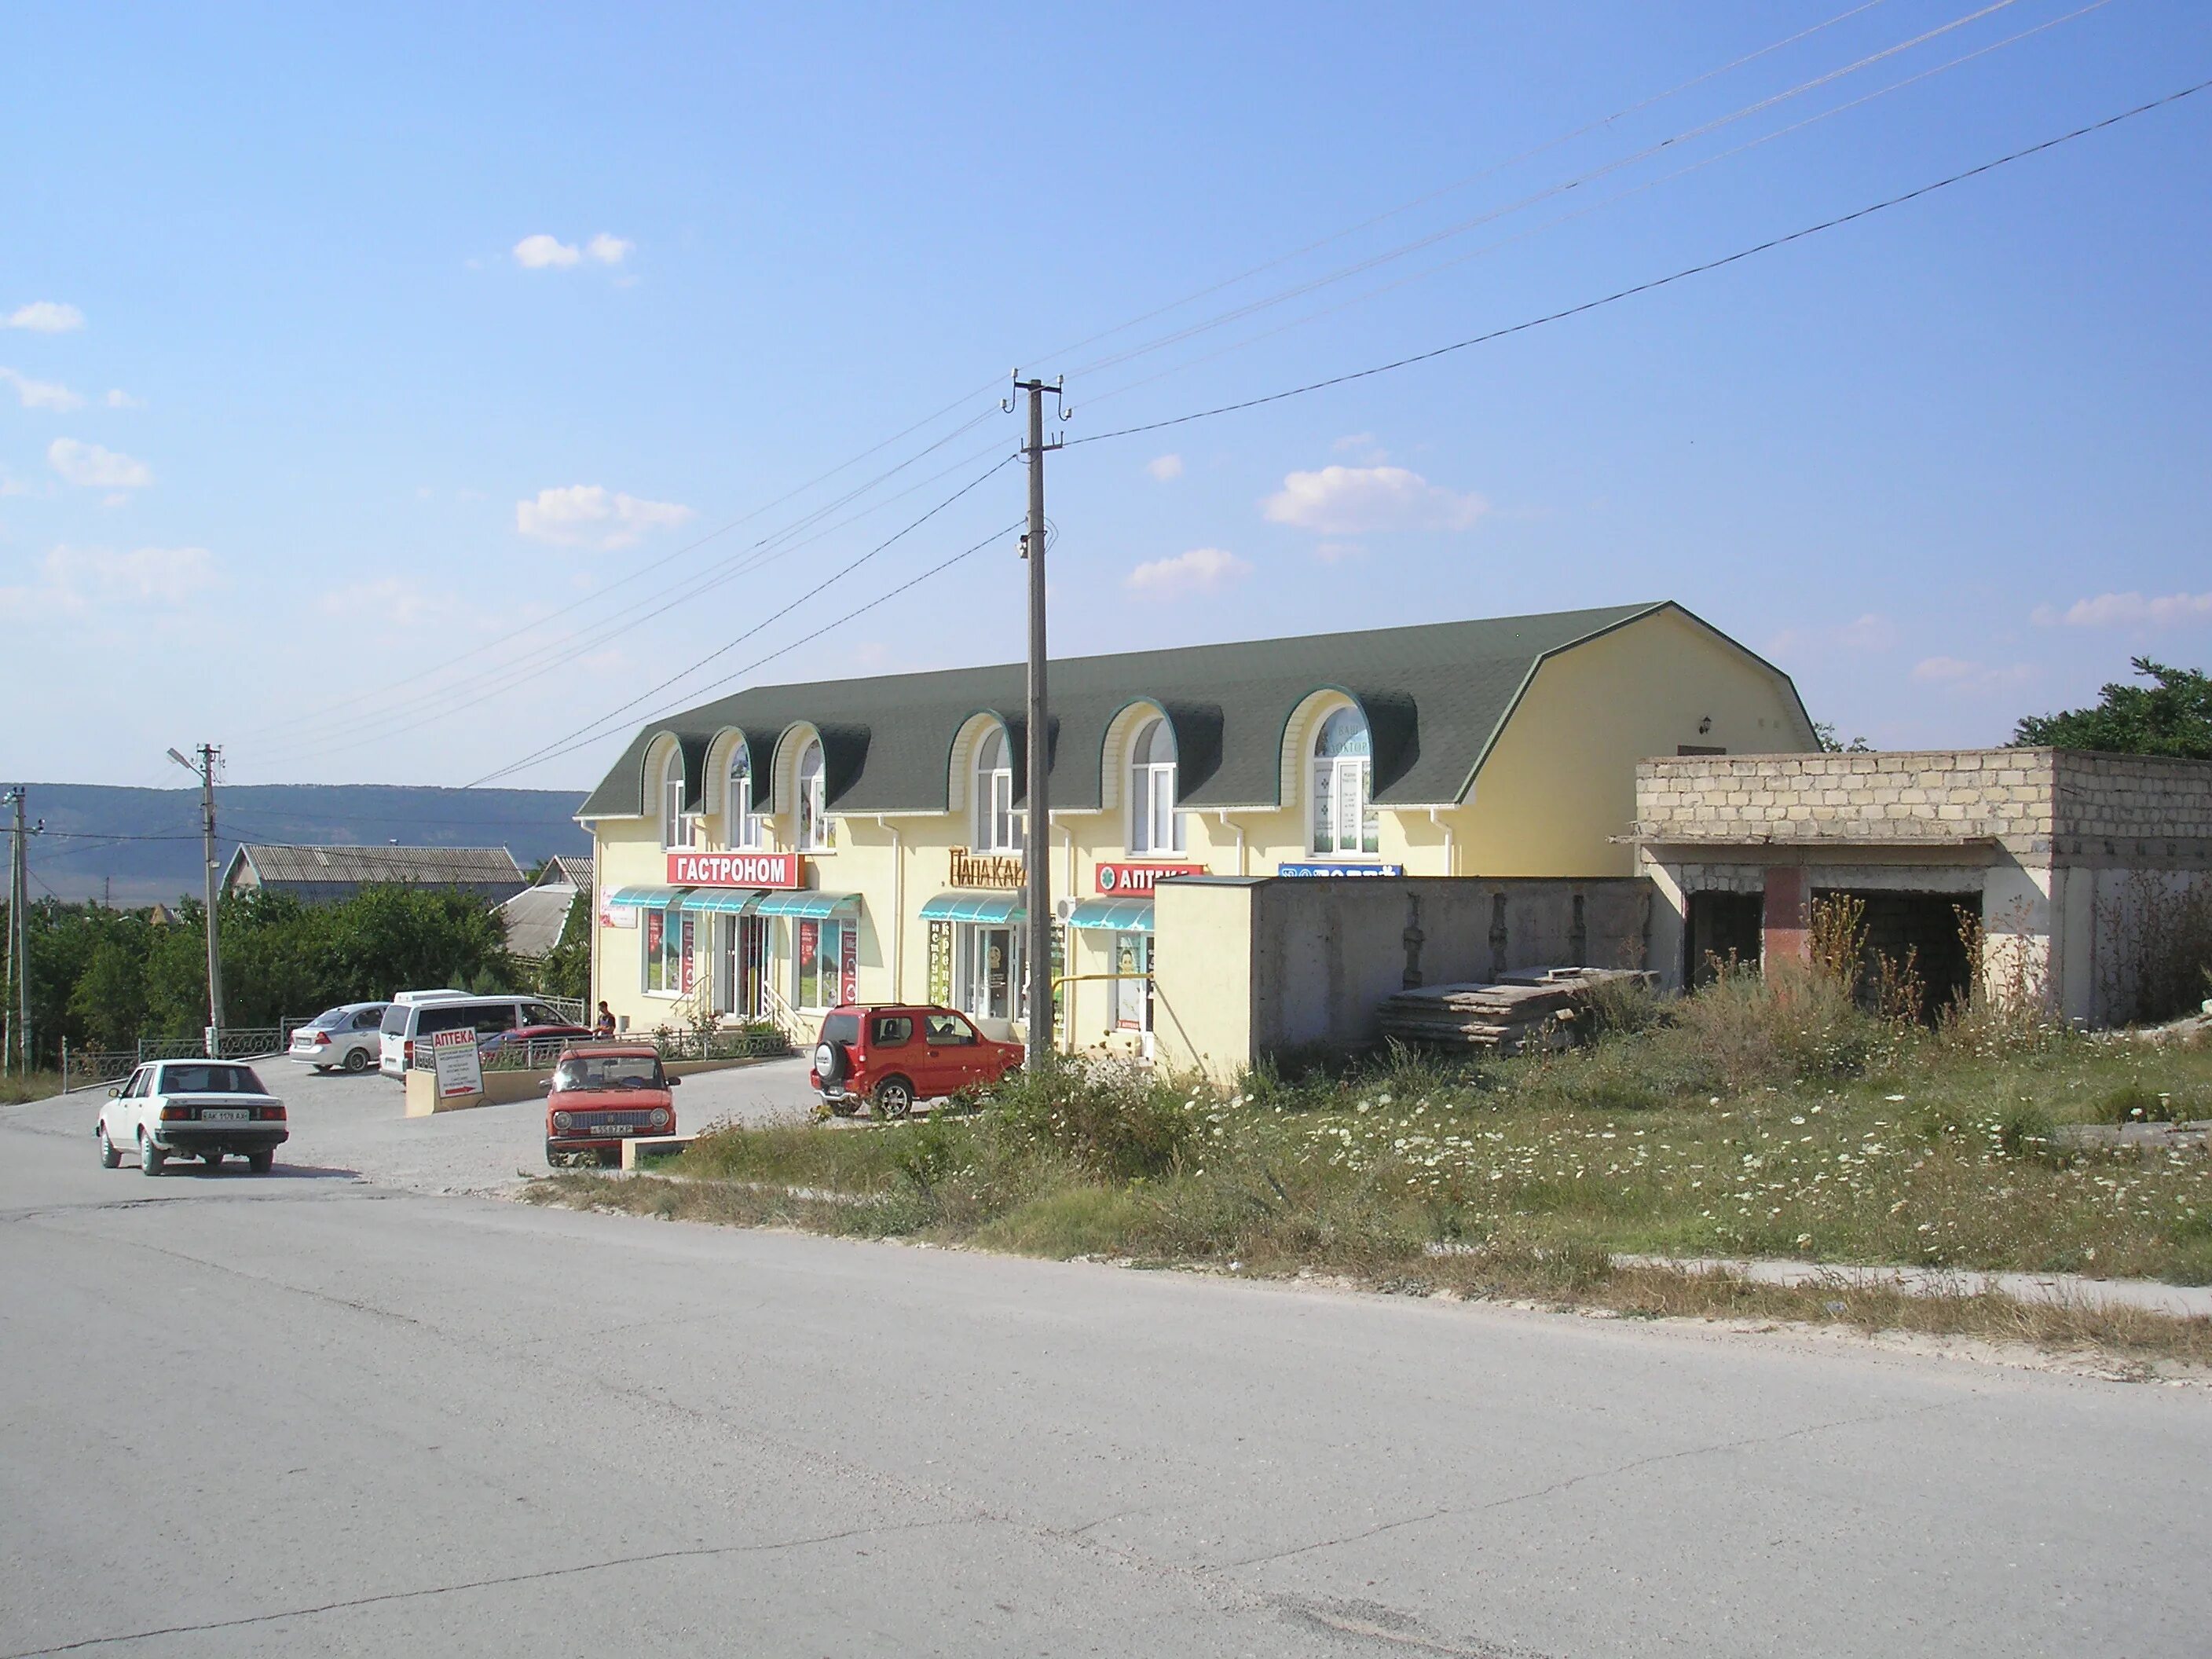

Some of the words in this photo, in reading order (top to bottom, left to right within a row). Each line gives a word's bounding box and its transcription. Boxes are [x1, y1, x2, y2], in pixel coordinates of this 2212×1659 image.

[676, 857, 786, 883] ГАСТРОНОМ
[1119, 869, 1189, 889] АПТ
[434, 1030, 475, 1047] АПТЕКА
